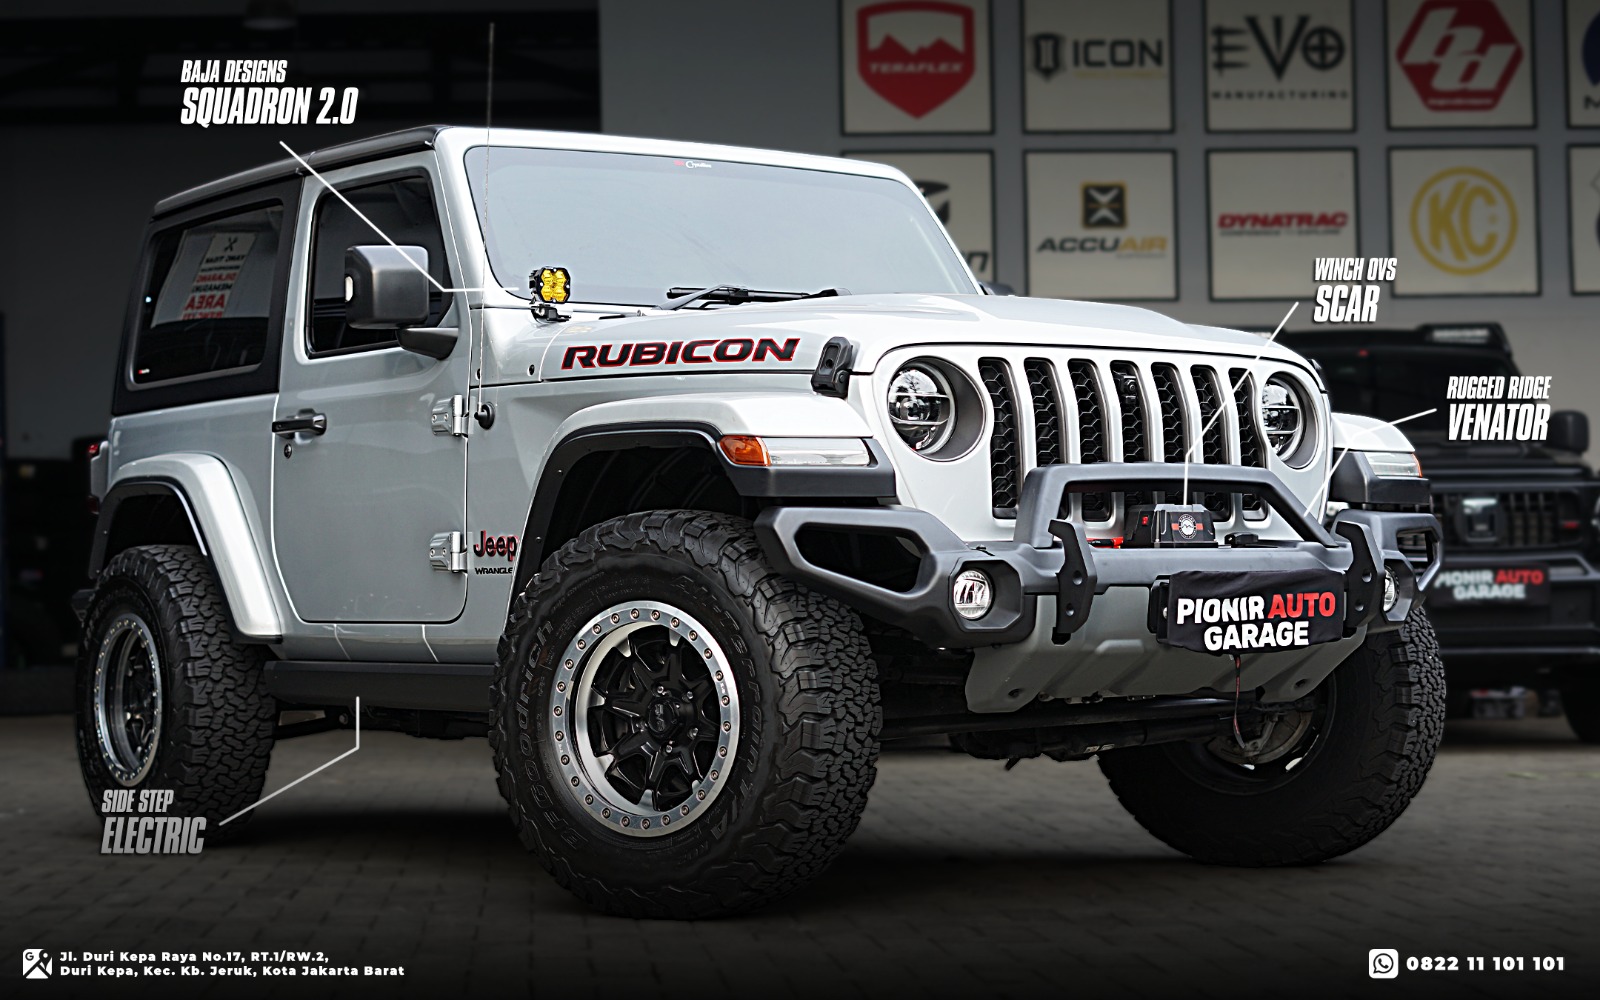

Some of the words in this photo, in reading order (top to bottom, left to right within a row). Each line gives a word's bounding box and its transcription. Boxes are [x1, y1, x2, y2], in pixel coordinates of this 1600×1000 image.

[1072, 38, 1164, 68] ICON
[868, 61, 964, 75] TERAFLEX
[1212, 90, 1349, 100] MANUFACTURING
[1218, 211, 1348, 229] DYNATRAC
[1036, 236, 1168, 253] ACCUAIR
[561, 338, 800, 370] RUBICON
[473, 530, 519, 562] Jeep
[1495, 568, 1544, 585] AUTO
[1453, 583, 1526, 601] GARAGE
[1177, 596, 1265, 625] PIONIR
[1268, 592, 1336, 619] AUTO
[1204, 621, 1309, 651] GARAGE
